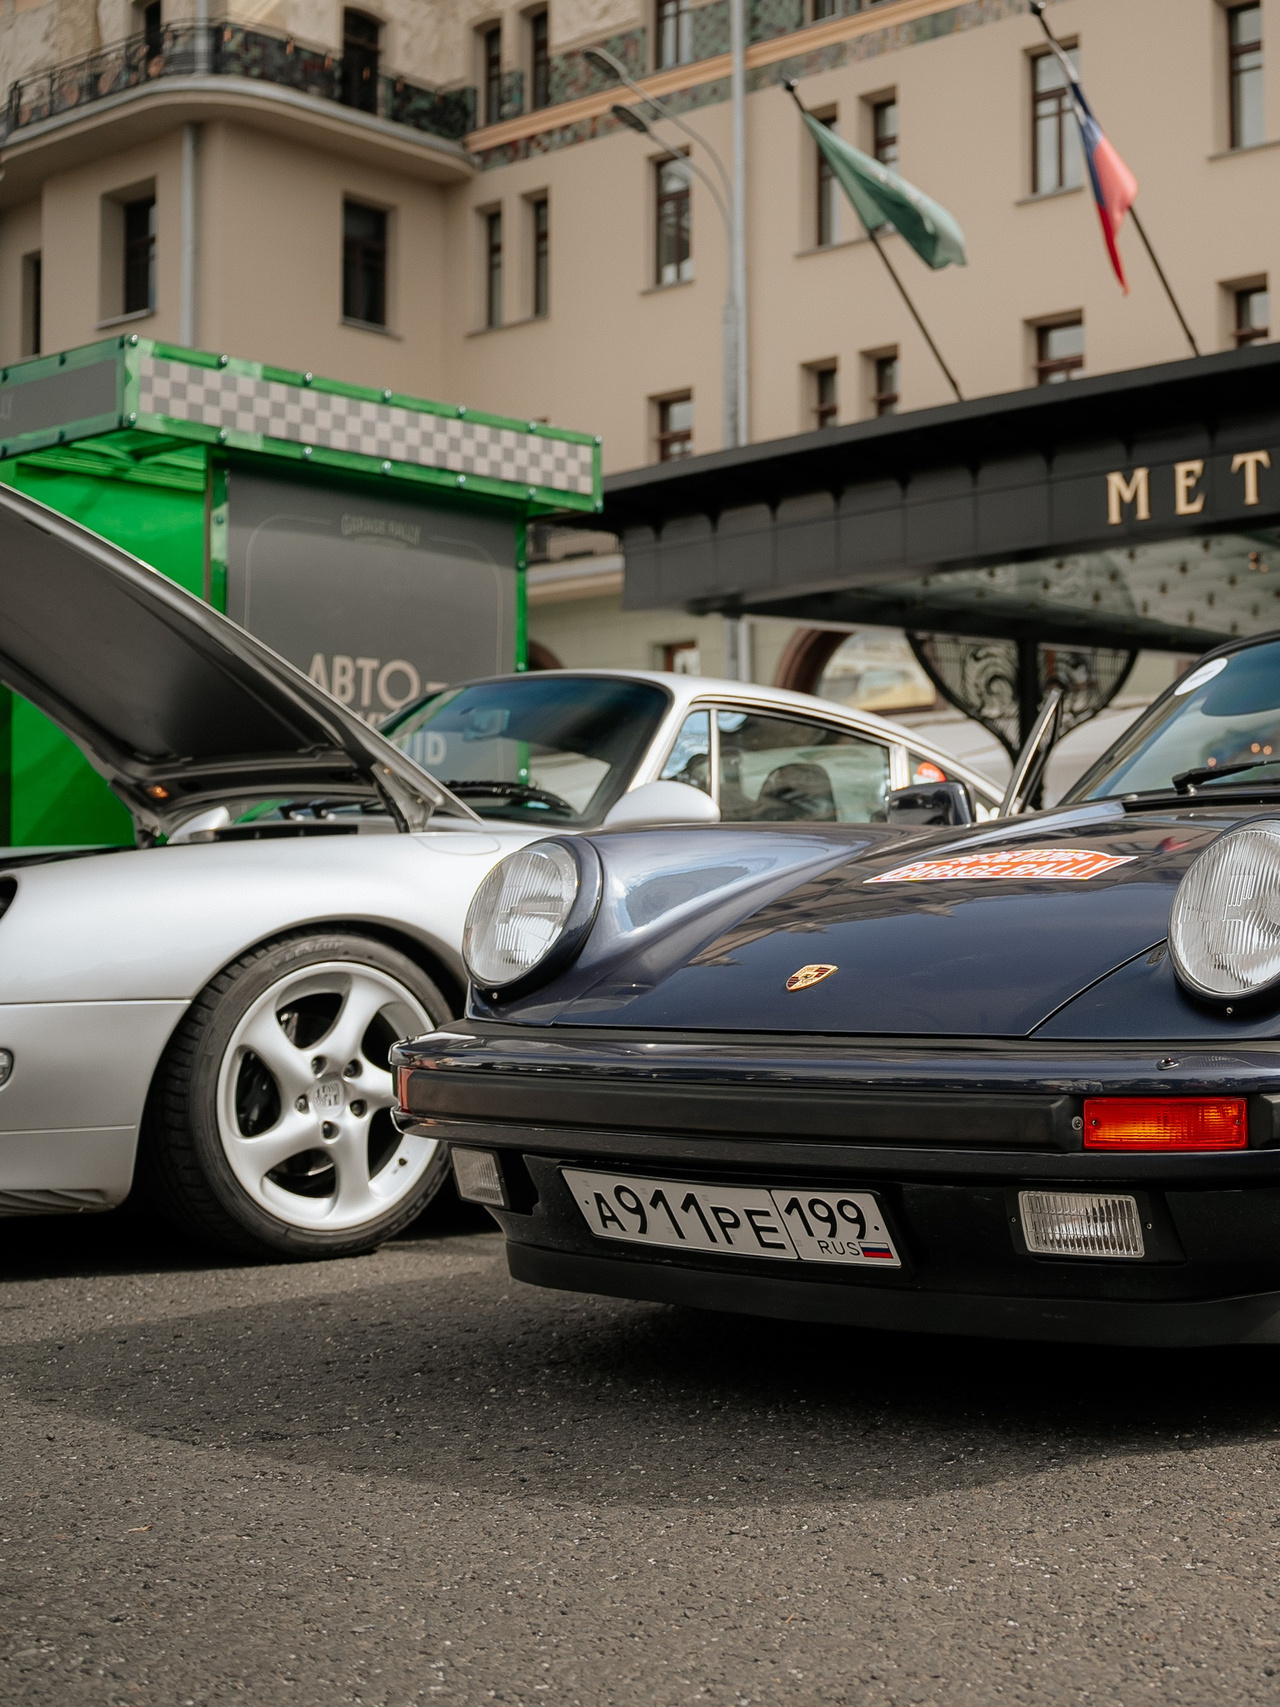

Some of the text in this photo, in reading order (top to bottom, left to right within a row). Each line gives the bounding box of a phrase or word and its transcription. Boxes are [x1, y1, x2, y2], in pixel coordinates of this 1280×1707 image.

[880, 859, 1126, 880] GARAGE RALLY
[784, 1196, 867, 1240] 199
[817, 1239, 860, 1257] RUS
